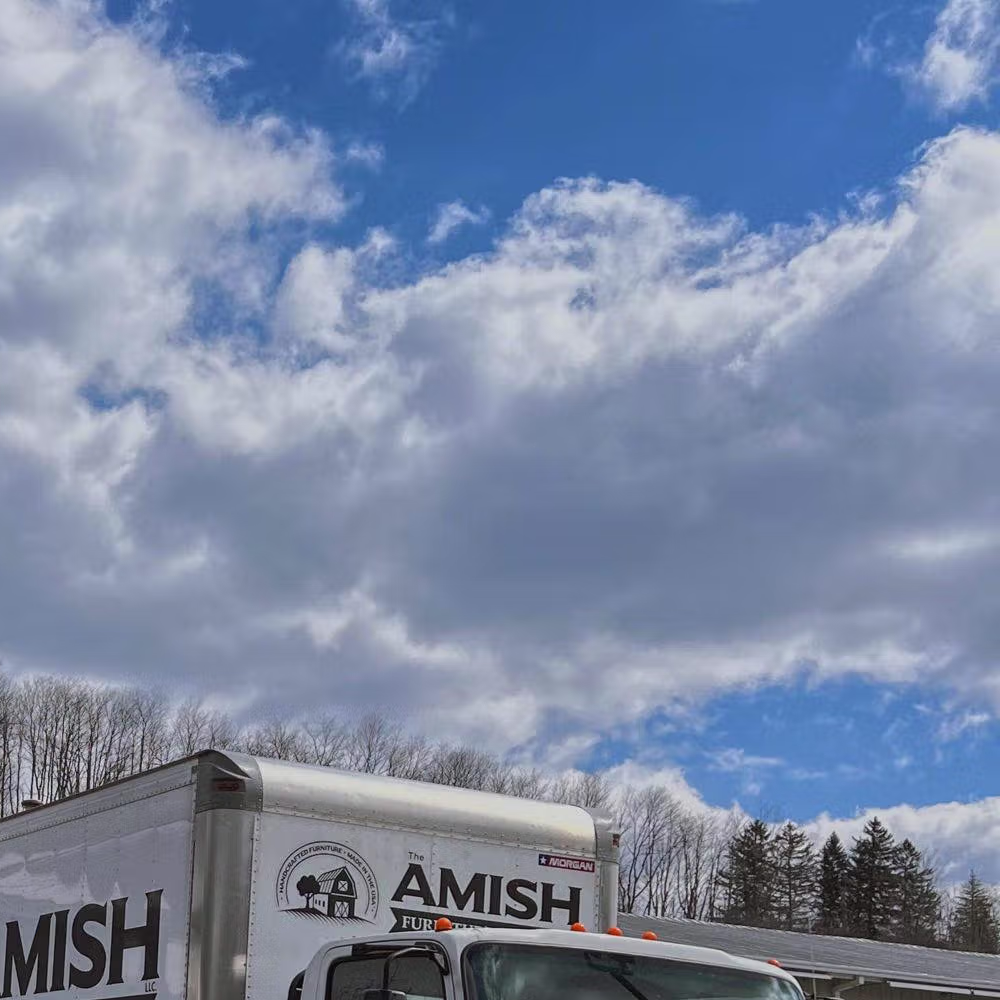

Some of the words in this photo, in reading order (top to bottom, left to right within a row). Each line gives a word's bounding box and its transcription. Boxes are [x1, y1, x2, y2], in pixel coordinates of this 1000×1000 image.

[408, 851, 425, 861] The
[279, 849, 309, 893] HANDCRAFTED
[308, 845, 342, 854] FURNITURE
[347, 852, 363, 868] MADE
[362, 866, 369, 875] IN
[367, 874, 375, 888] THE
[549, 857, 594, 872] MORGAN
[391, 863, 582, 925] AMISH
[144, 981, 157, 992] LLC
